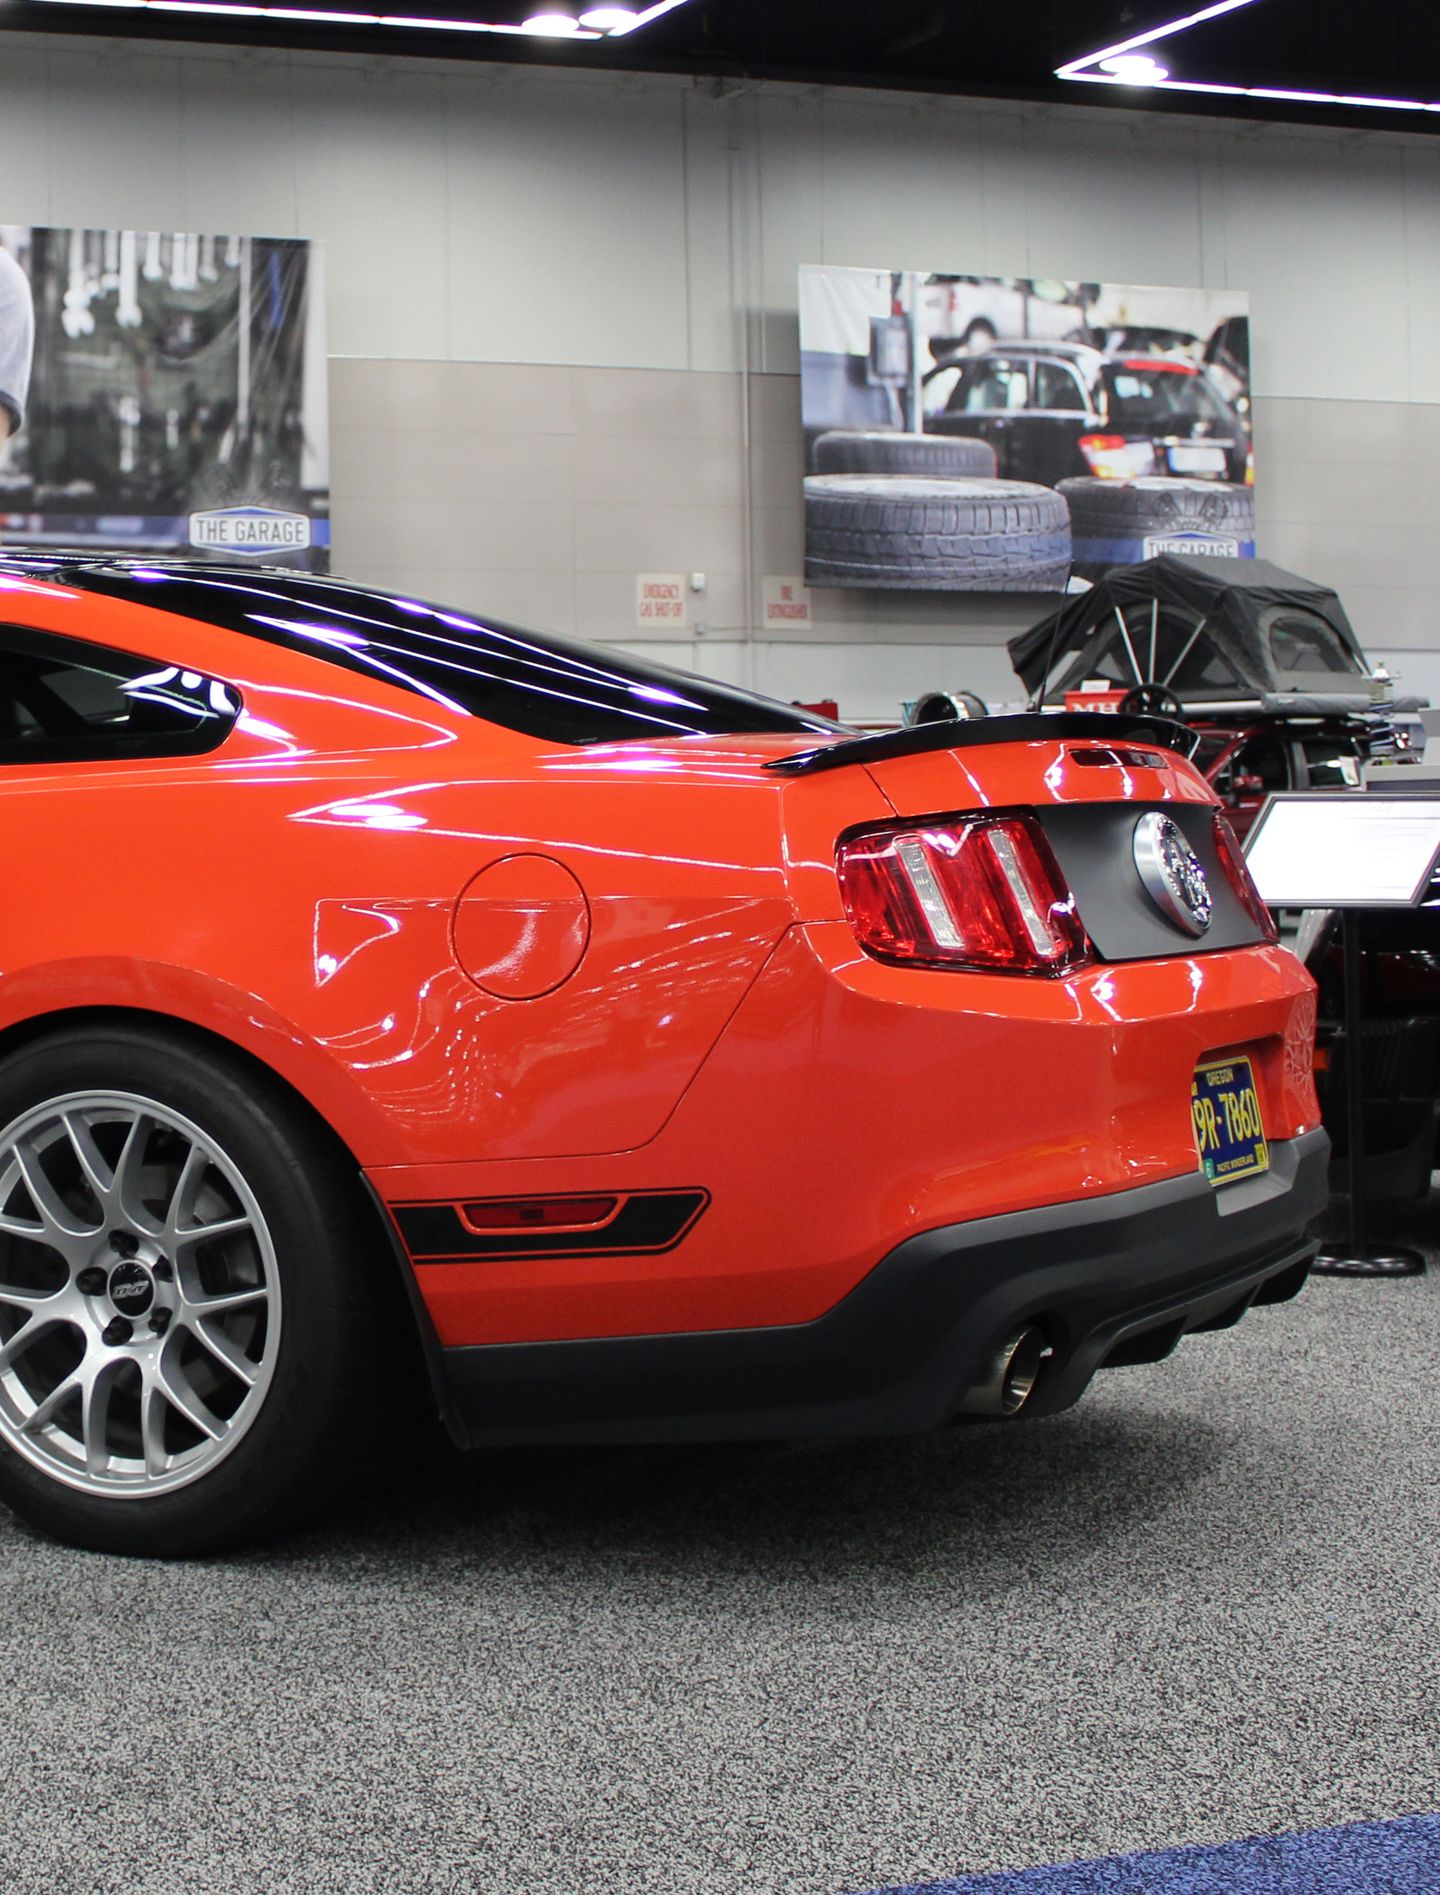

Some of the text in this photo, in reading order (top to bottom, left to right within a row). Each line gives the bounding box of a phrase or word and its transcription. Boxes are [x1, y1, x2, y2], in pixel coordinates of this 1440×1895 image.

[197, 520, 304, 543] THE GARAGE
[1206, 1067, 1234, 1087] OREGON
